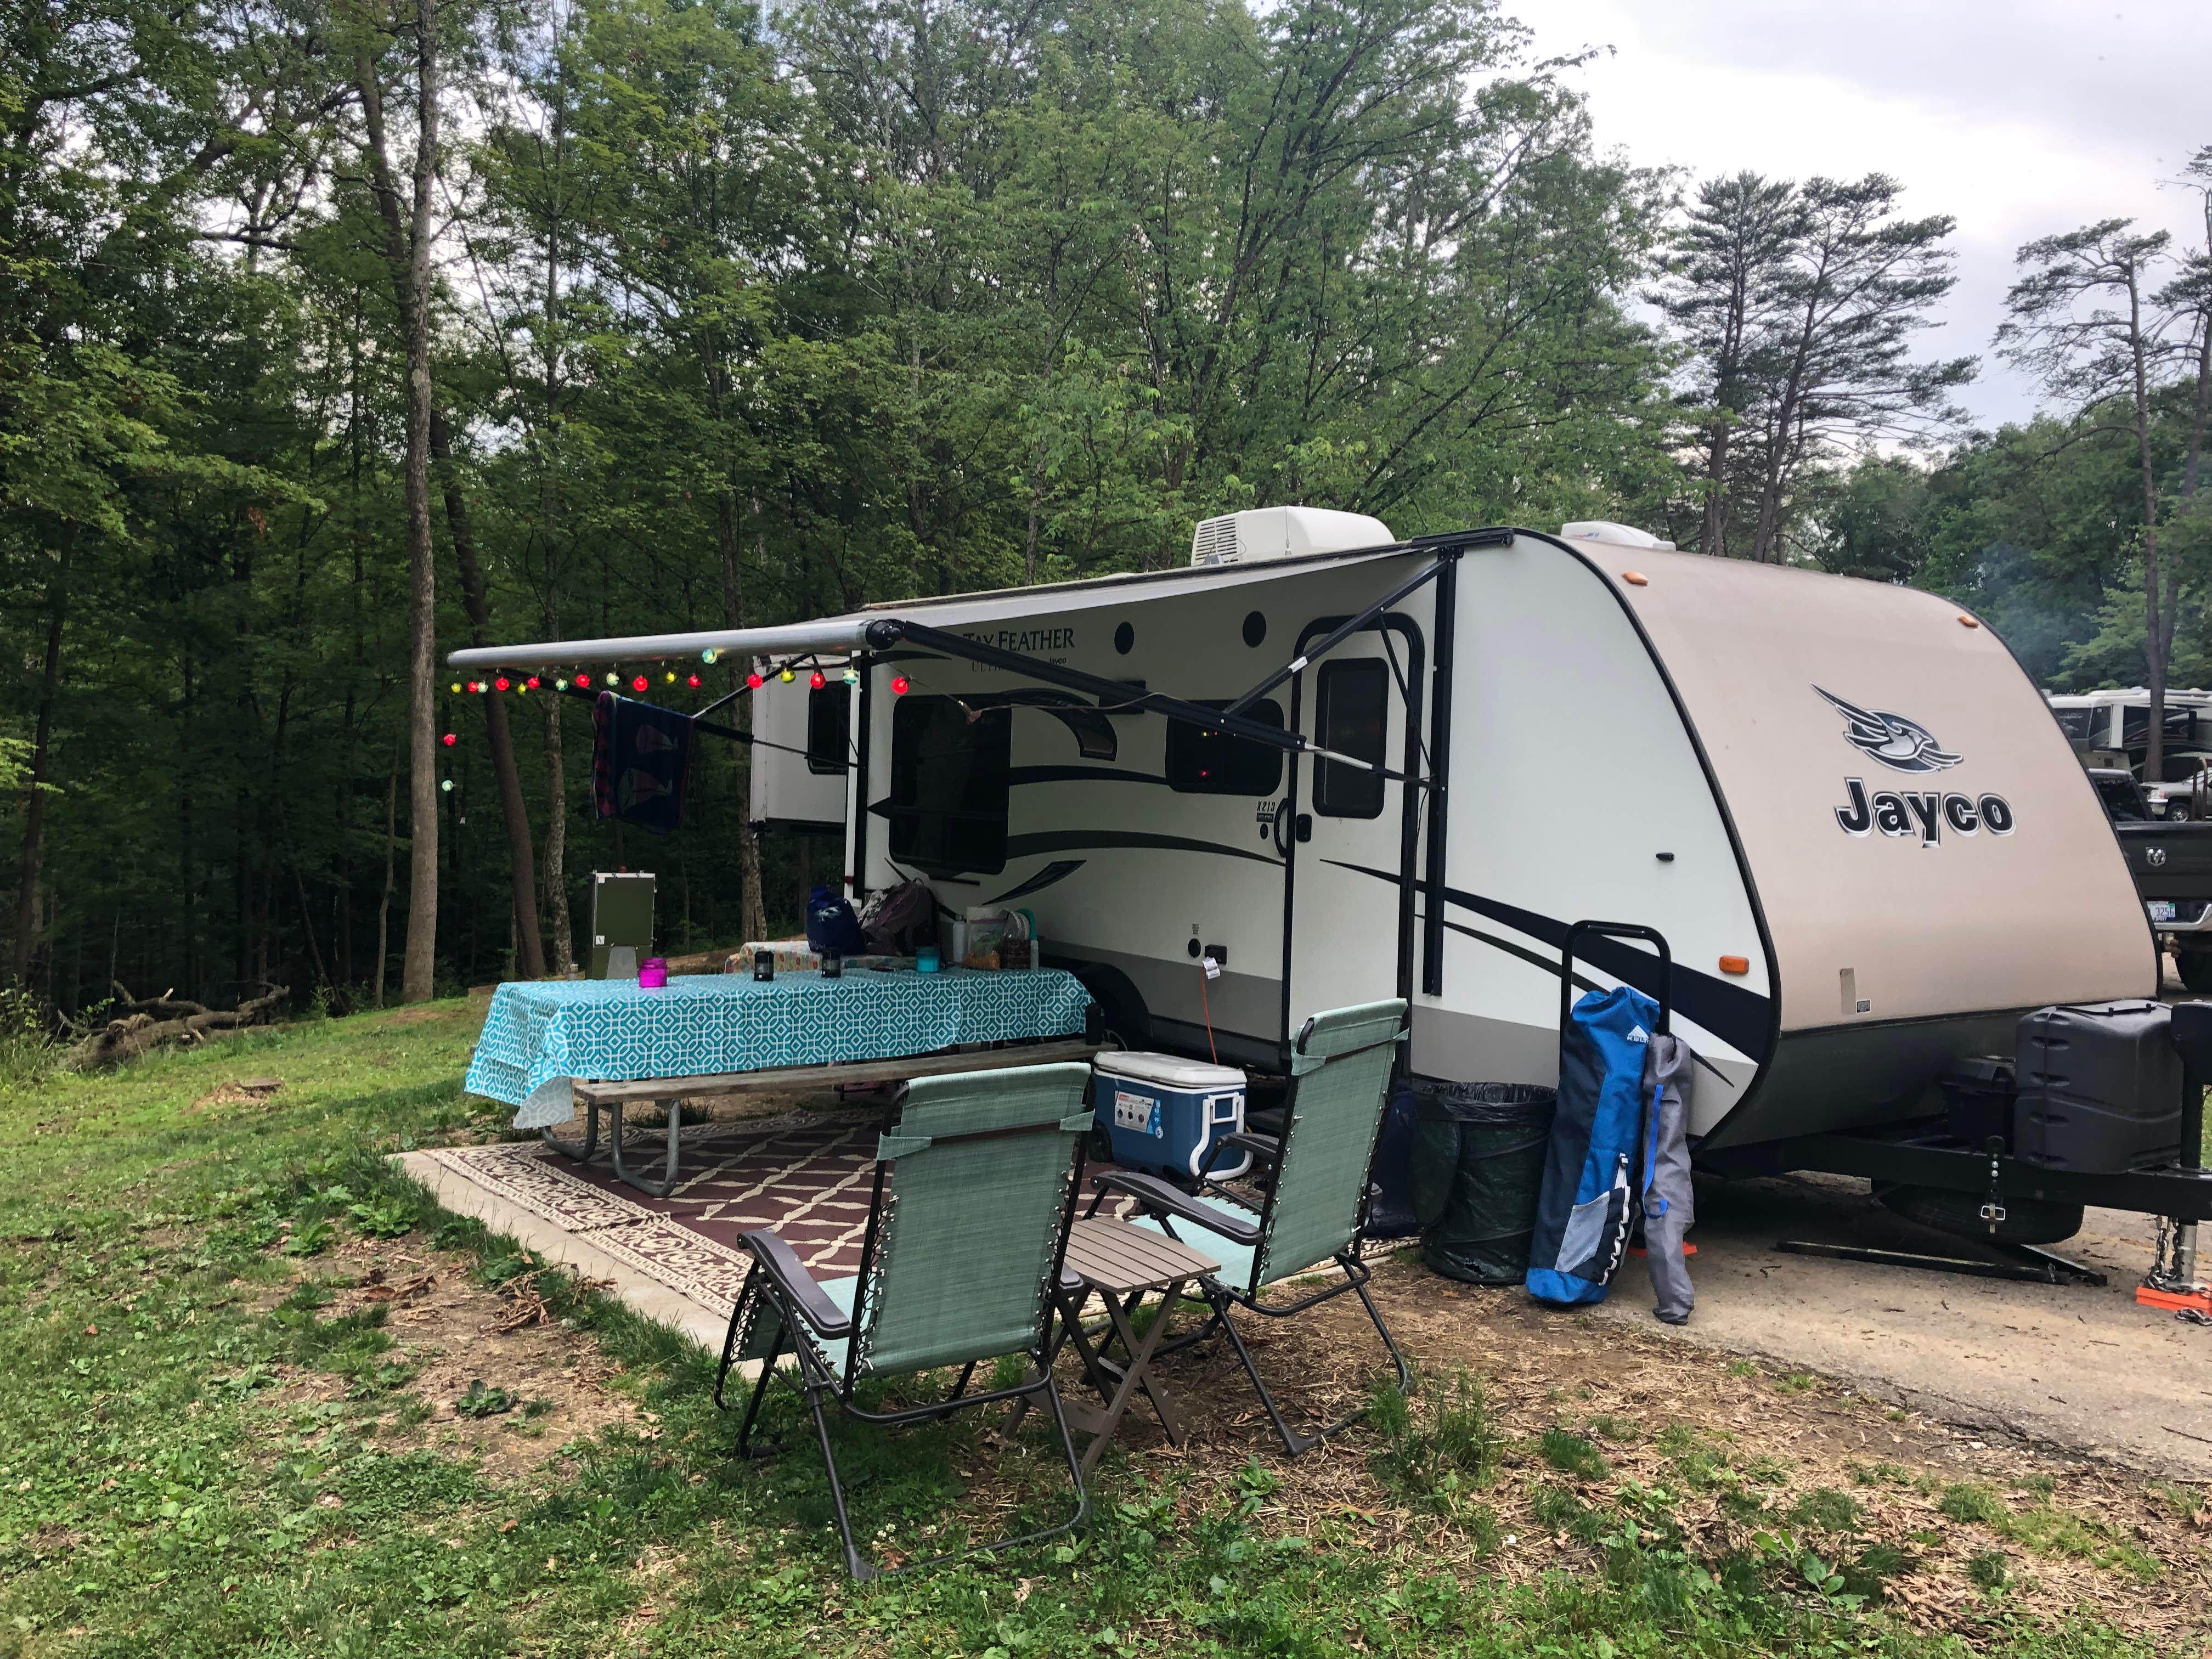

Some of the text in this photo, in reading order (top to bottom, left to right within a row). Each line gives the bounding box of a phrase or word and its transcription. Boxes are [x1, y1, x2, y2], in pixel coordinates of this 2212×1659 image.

[998, 628, 1075, 651] FEATHER
[1257, 800, 1276, 812] X213
[1834, 777, 2017, 848] Jayco
